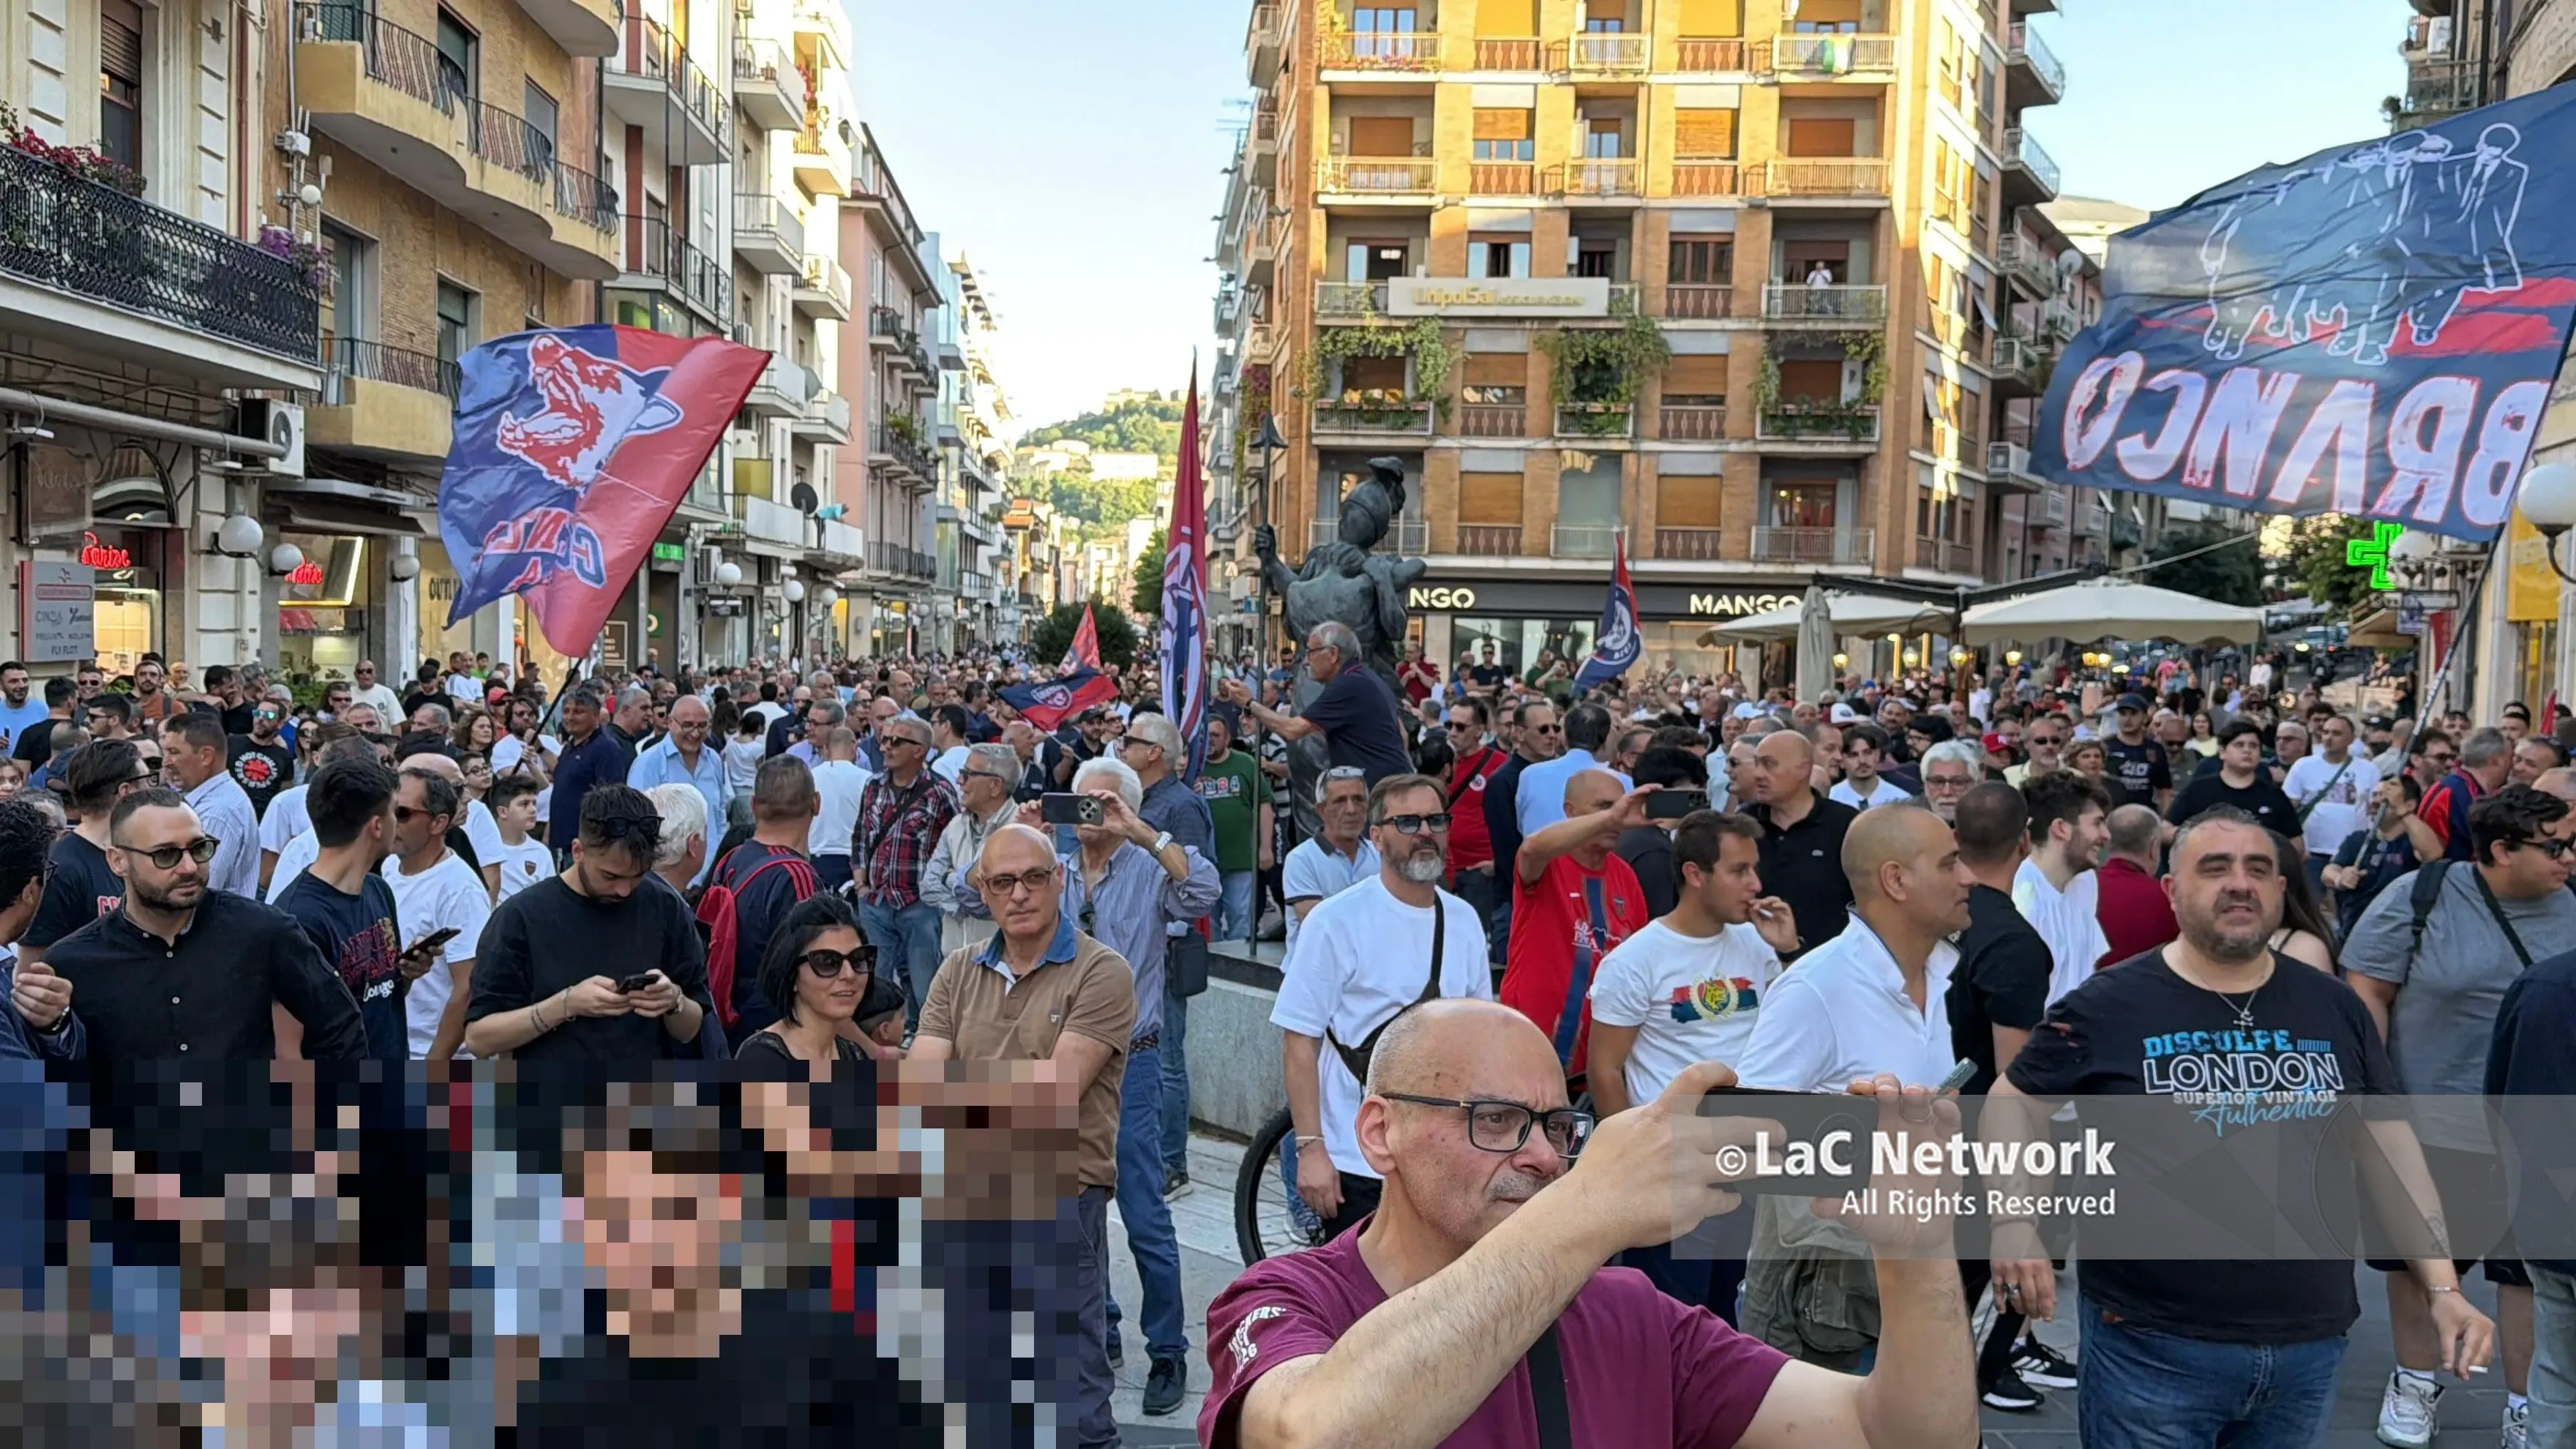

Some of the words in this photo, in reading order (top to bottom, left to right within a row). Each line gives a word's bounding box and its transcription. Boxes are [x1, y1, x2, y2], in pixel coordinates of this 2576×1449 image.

[1413, 284, 1496, 310] UnipolSai
[1409, 587, 1475, 608] NGO
[2143, 1052, 2345, 1094] LONDON
[2173, 1091, 2258, 1105] SUPERIOR
[2263, 1089, 2337, 1104] VINTAGE
